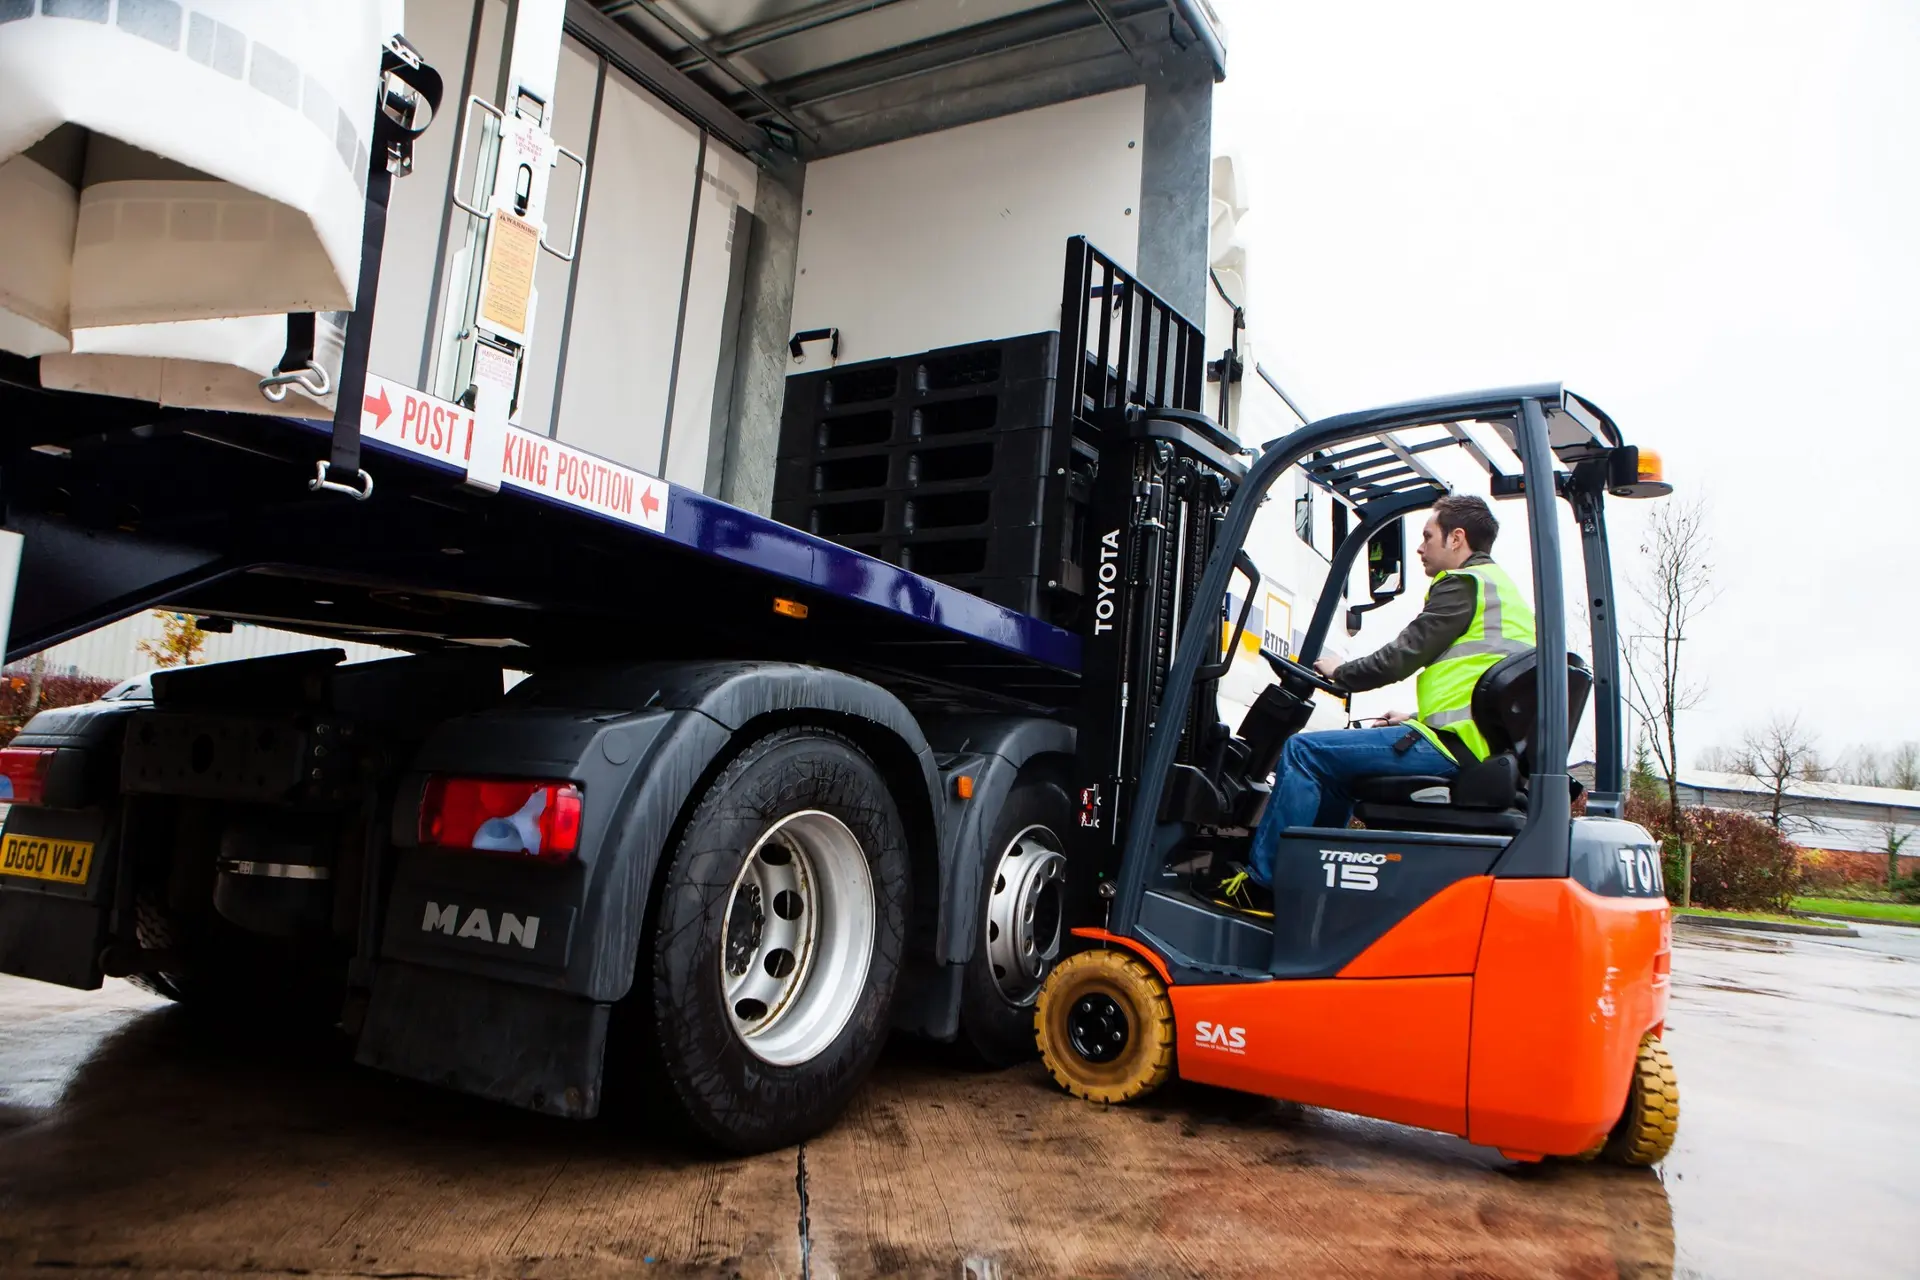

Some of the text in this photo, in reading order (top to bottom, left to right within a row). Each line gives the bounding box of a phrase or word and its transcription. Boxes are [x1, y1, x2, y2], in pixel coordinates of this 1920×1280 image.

[505, 218, 538, 236] WARNING
[481, 349, 515, 367] IMPORTANT
[400, 395, 459, 455] POST
[555, 450, 634, 514] POSITION
[1094, 529, 1120, 636] TOYOTA
[1264, 629, 1290, 658] RTITB
[4, 839, 49, 872] DG60
[1322, 863, 1379, 891] 15
[421, 901, 540, 950] MAN
[1195, 1020, 1246, 1049] SAS
